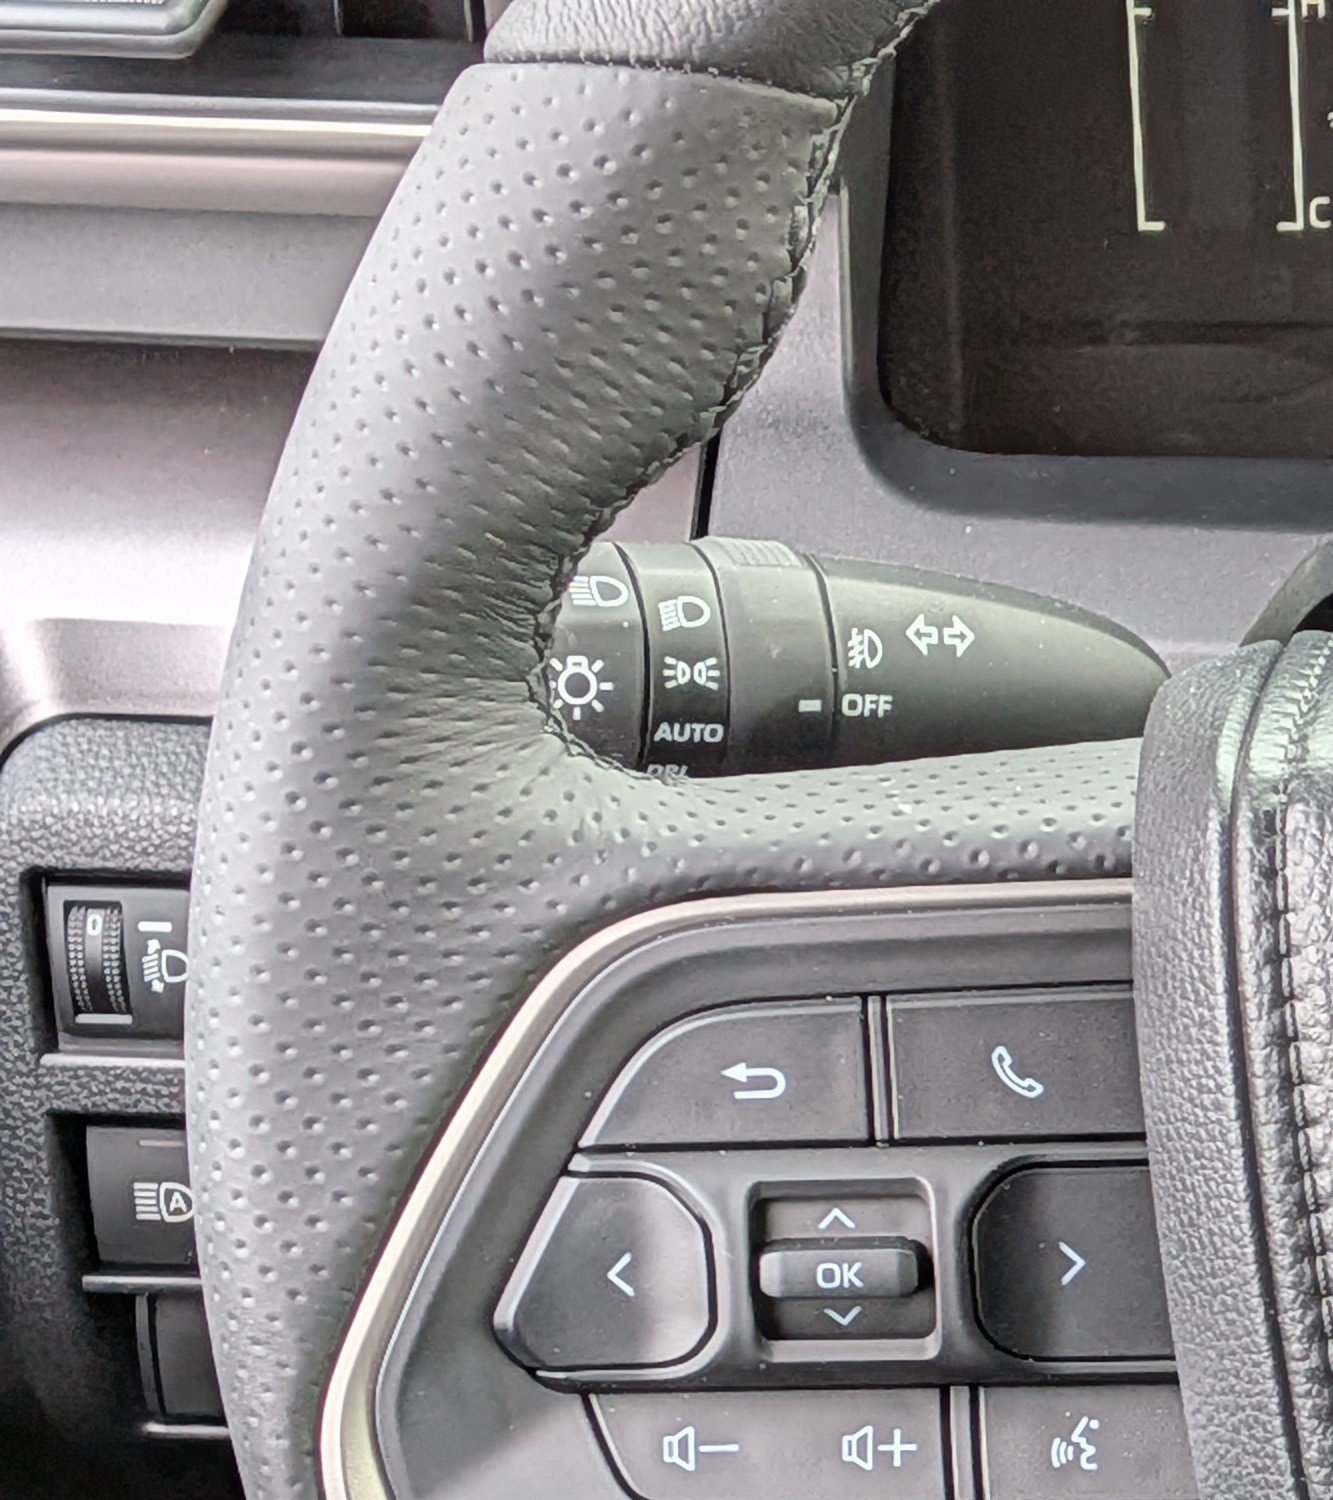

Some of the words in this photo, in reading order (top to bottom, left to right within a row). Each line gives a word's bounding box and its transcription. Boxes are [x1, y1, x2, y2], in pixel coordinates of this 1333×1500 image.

[1309, 197, 1332, 229] C
[841, 693, 894, 718] OFF
[653, 722, 725, 744] AUTO
[816, 1261, 864, 1288] OK
